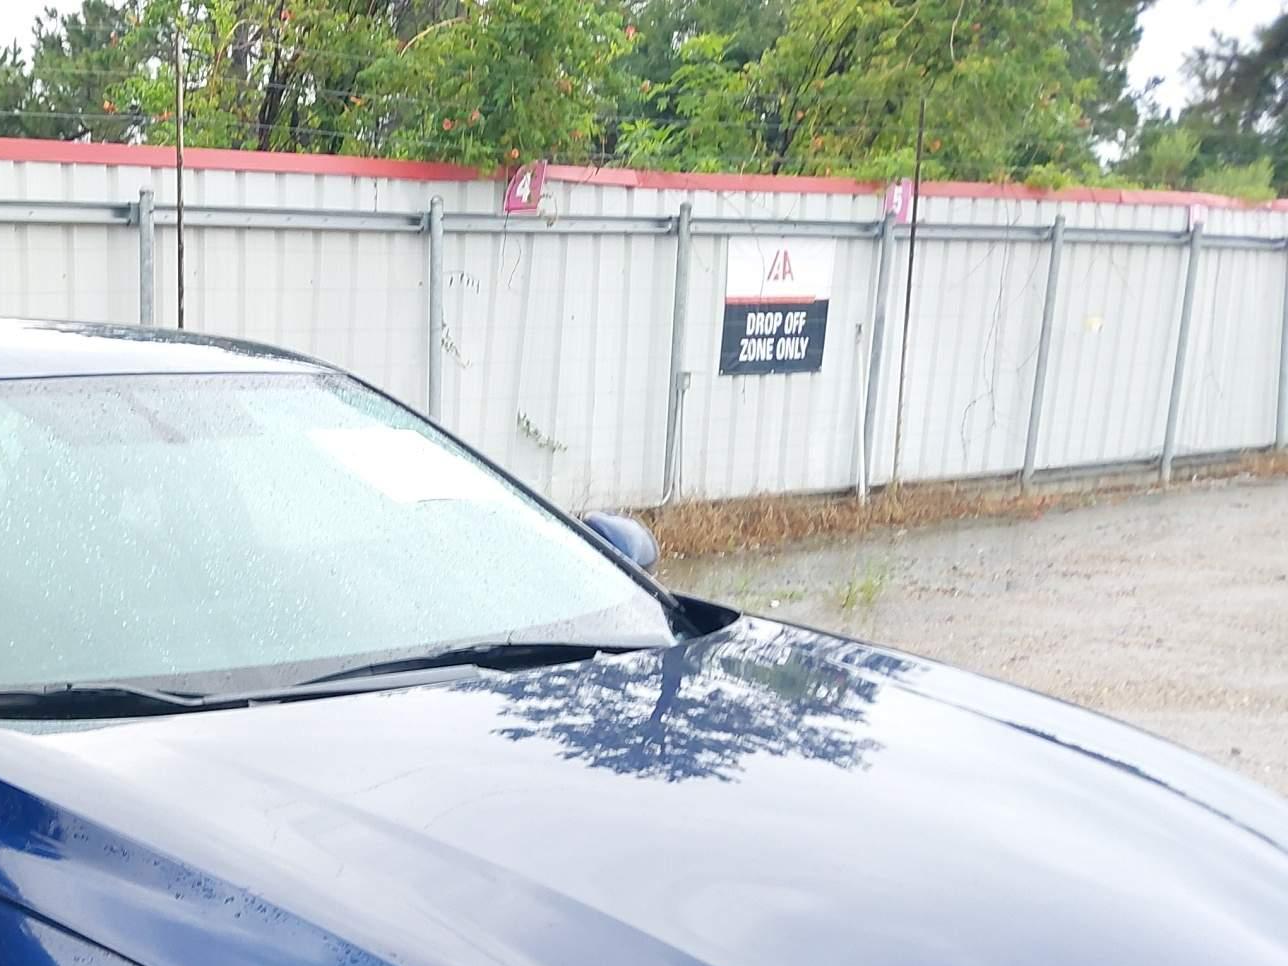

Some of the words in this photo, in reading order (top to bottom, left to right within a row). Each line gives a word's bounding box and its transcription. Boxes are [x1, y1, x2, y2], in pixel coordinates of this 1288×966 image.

[515, 171, 531, 202] 4
[746, 312, 783, 336] DROP
[784, 311, 807, 335] OFF
[738, 338, 774, 362] ZONE
[775, 336, 809, 361] ONLY
